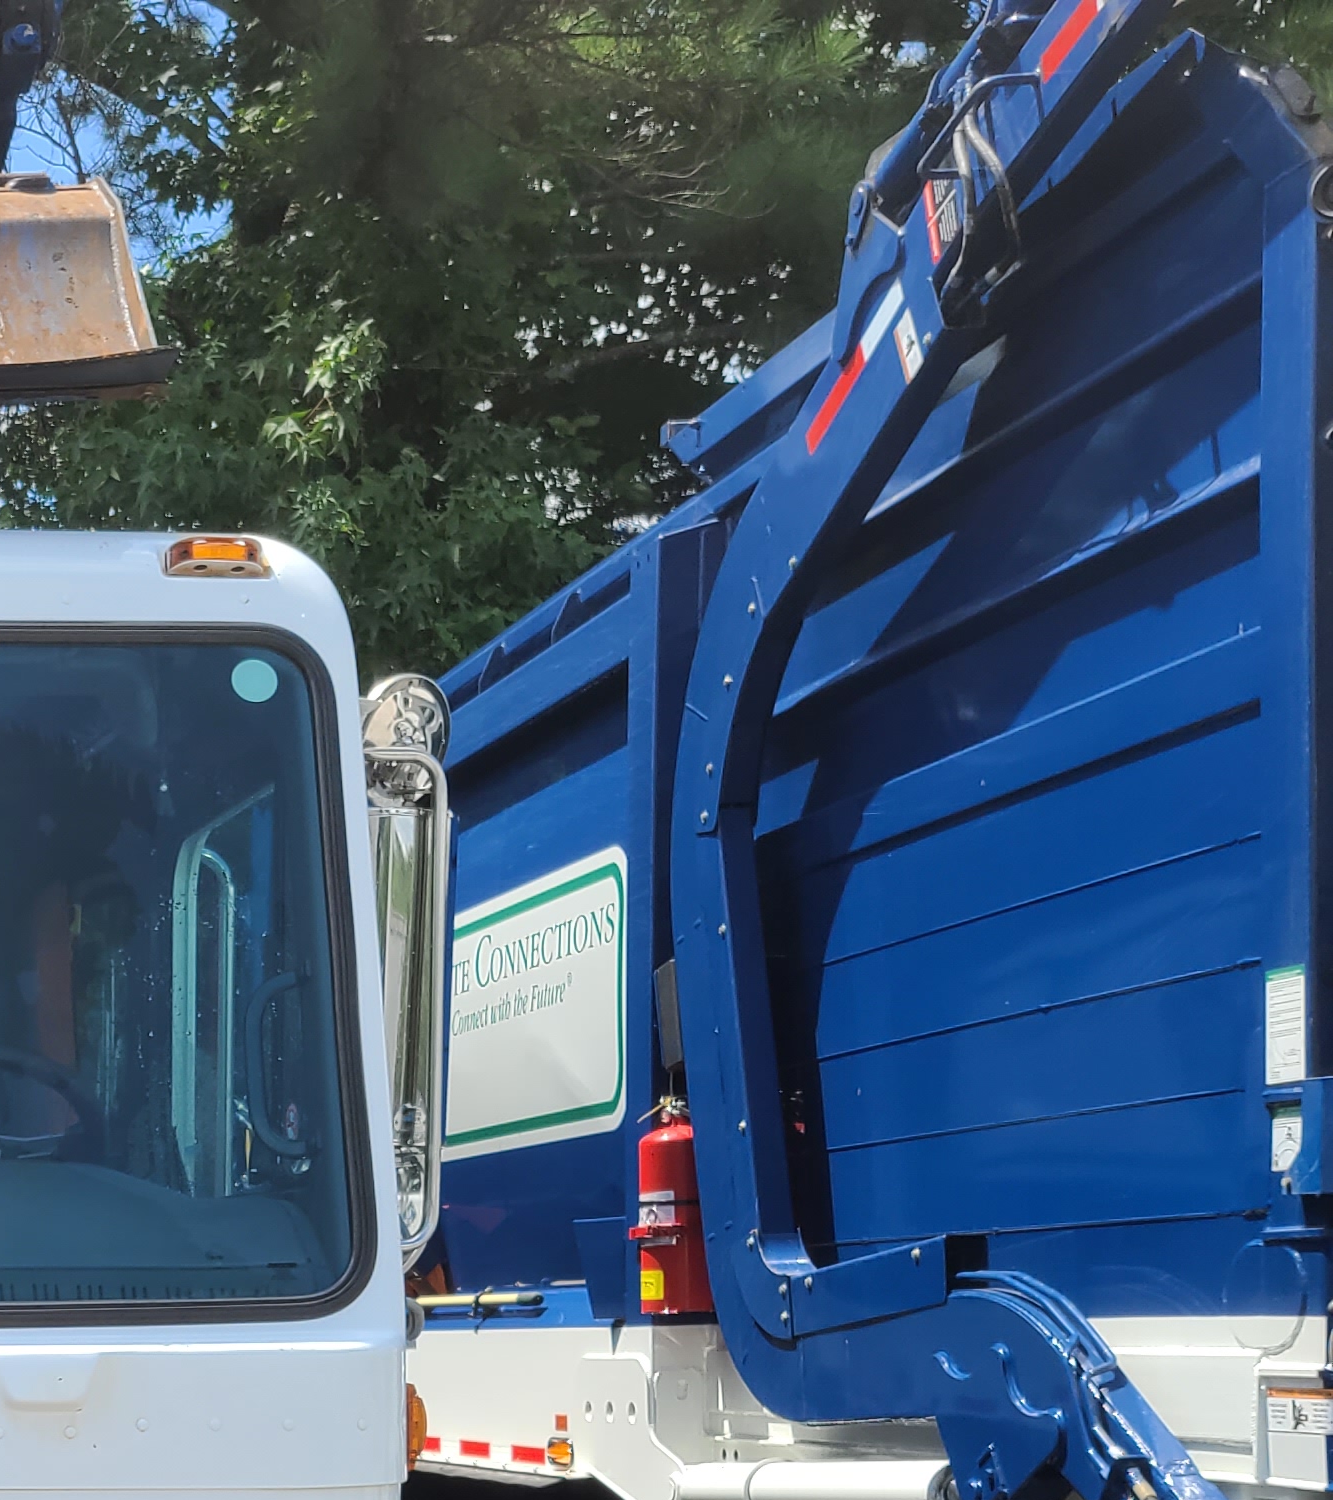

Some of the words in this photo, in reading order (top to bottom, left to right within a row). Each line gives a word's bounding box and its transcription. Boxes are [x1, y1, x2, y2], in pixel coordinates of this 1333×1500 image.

[452, 1003, 489, 1036] Connect
[490, 992, 511, 1024] with
[513, 988, 528, 1017] the
